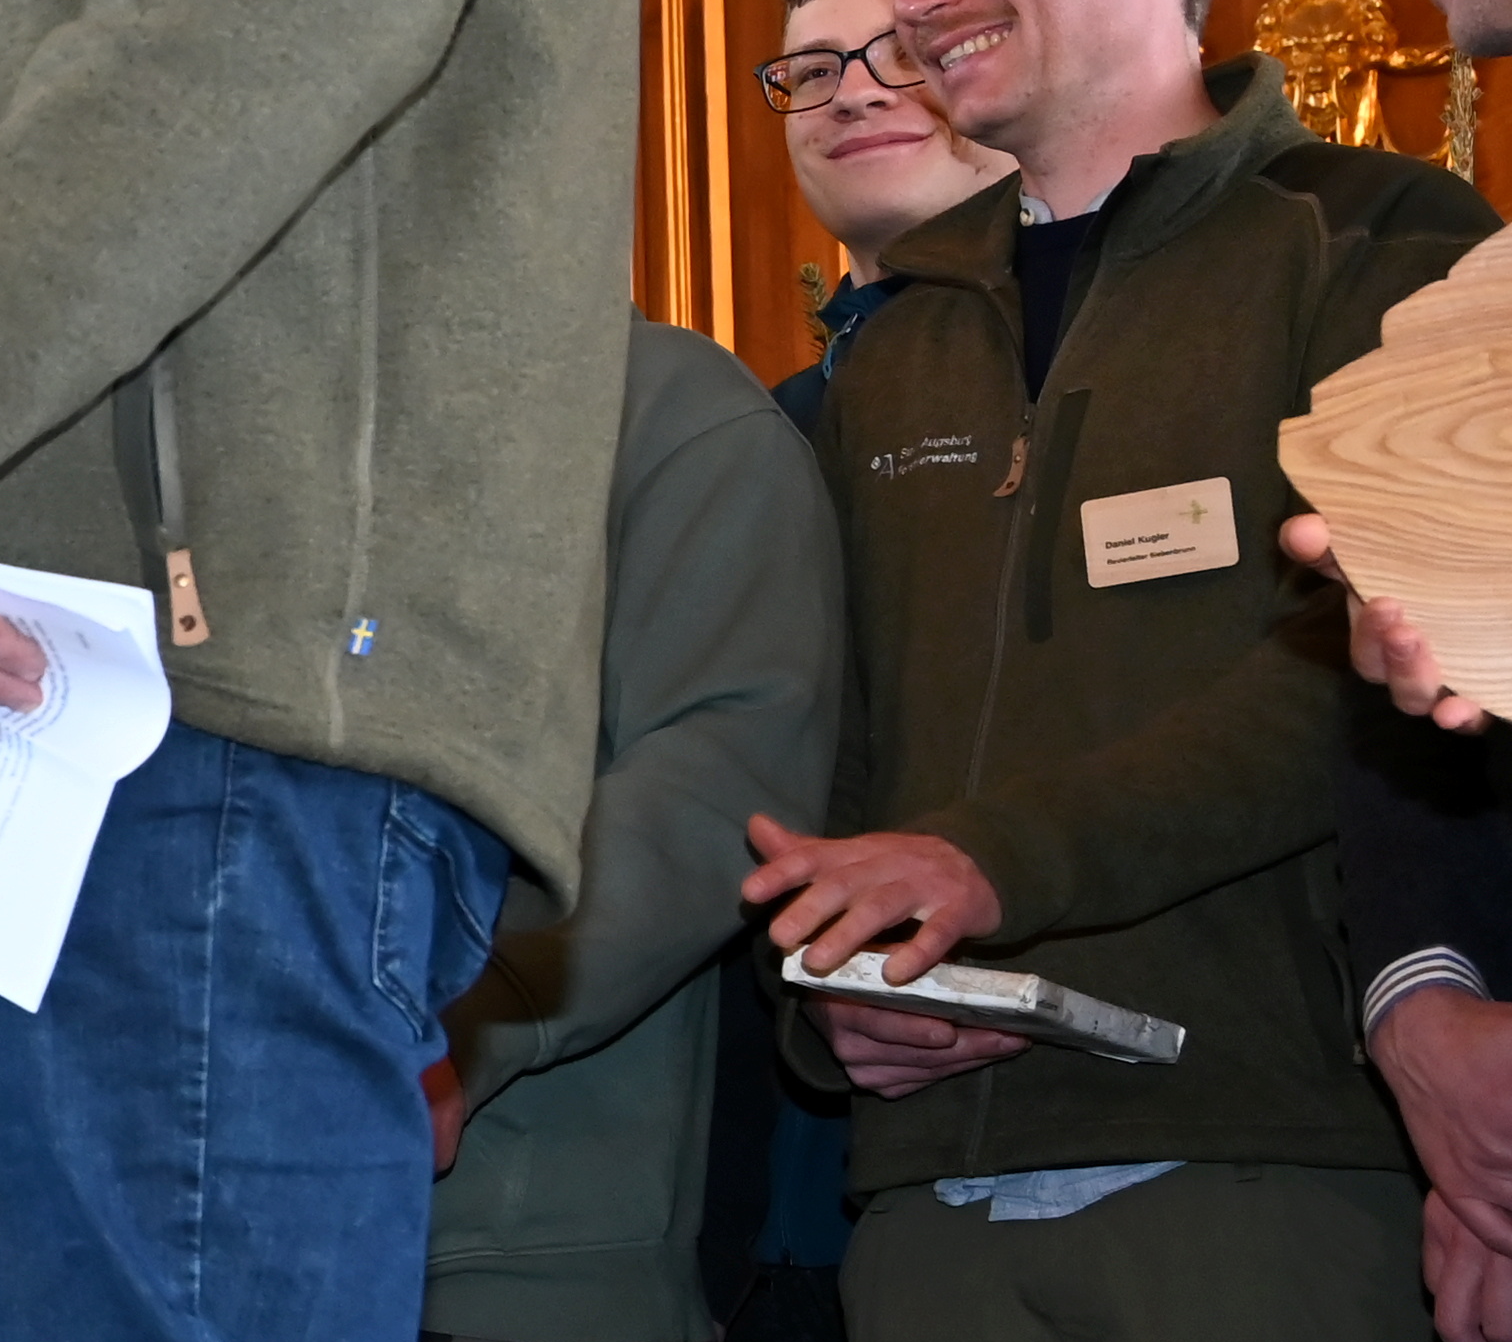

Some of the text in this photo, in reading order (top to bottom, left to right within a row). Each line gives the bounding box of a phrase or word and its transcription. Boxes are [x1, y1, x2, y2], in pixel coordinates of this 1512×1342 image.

[921, 435, 972, 448] Augsburg
[1105, 532, 1169, 549] Daniel Kugler
